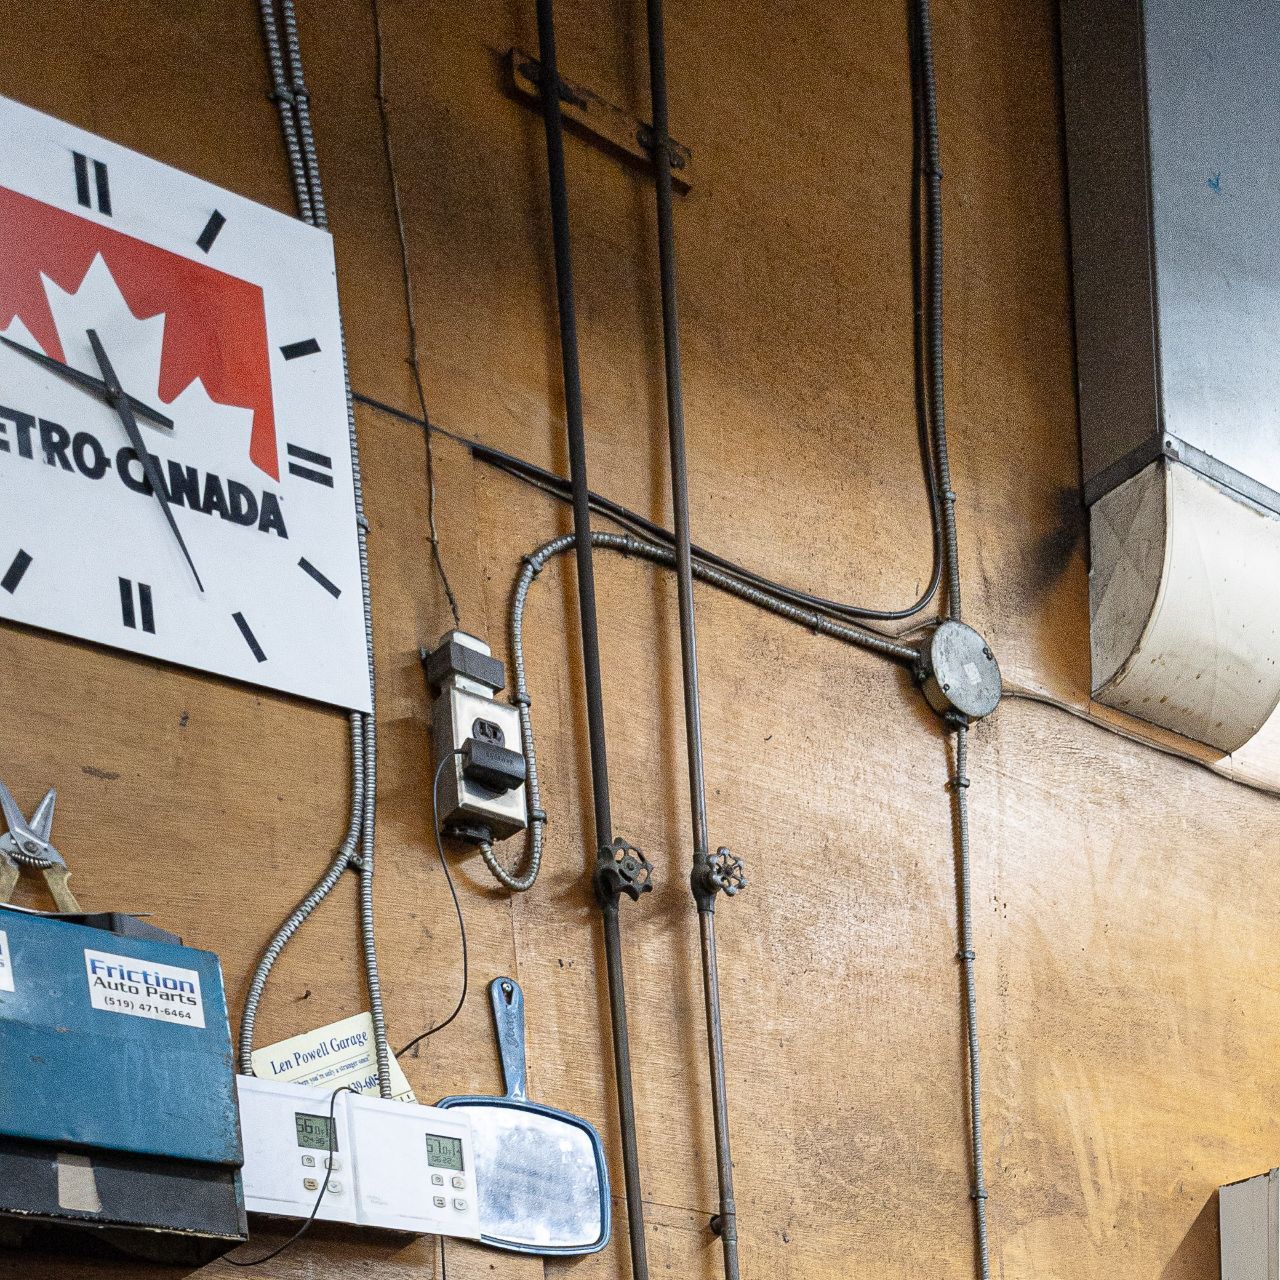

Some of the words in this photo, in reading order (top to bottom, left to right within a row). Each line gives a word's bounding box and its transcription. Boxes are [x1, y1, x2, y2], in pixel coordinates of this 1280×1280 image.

[89, 958, 195, 994] Friction
[93, 976, 139, 995] Auto
[146, 986, 197, 1006] Parts
[104, 996, 134, 1010] (519)
[139, 1003, 192, 1020] 471-6464
[270, 1059, 293, 1075] Len
[293, 1042, 330, 1067] Powell
[330, 1030, 368, 1053] Garage
